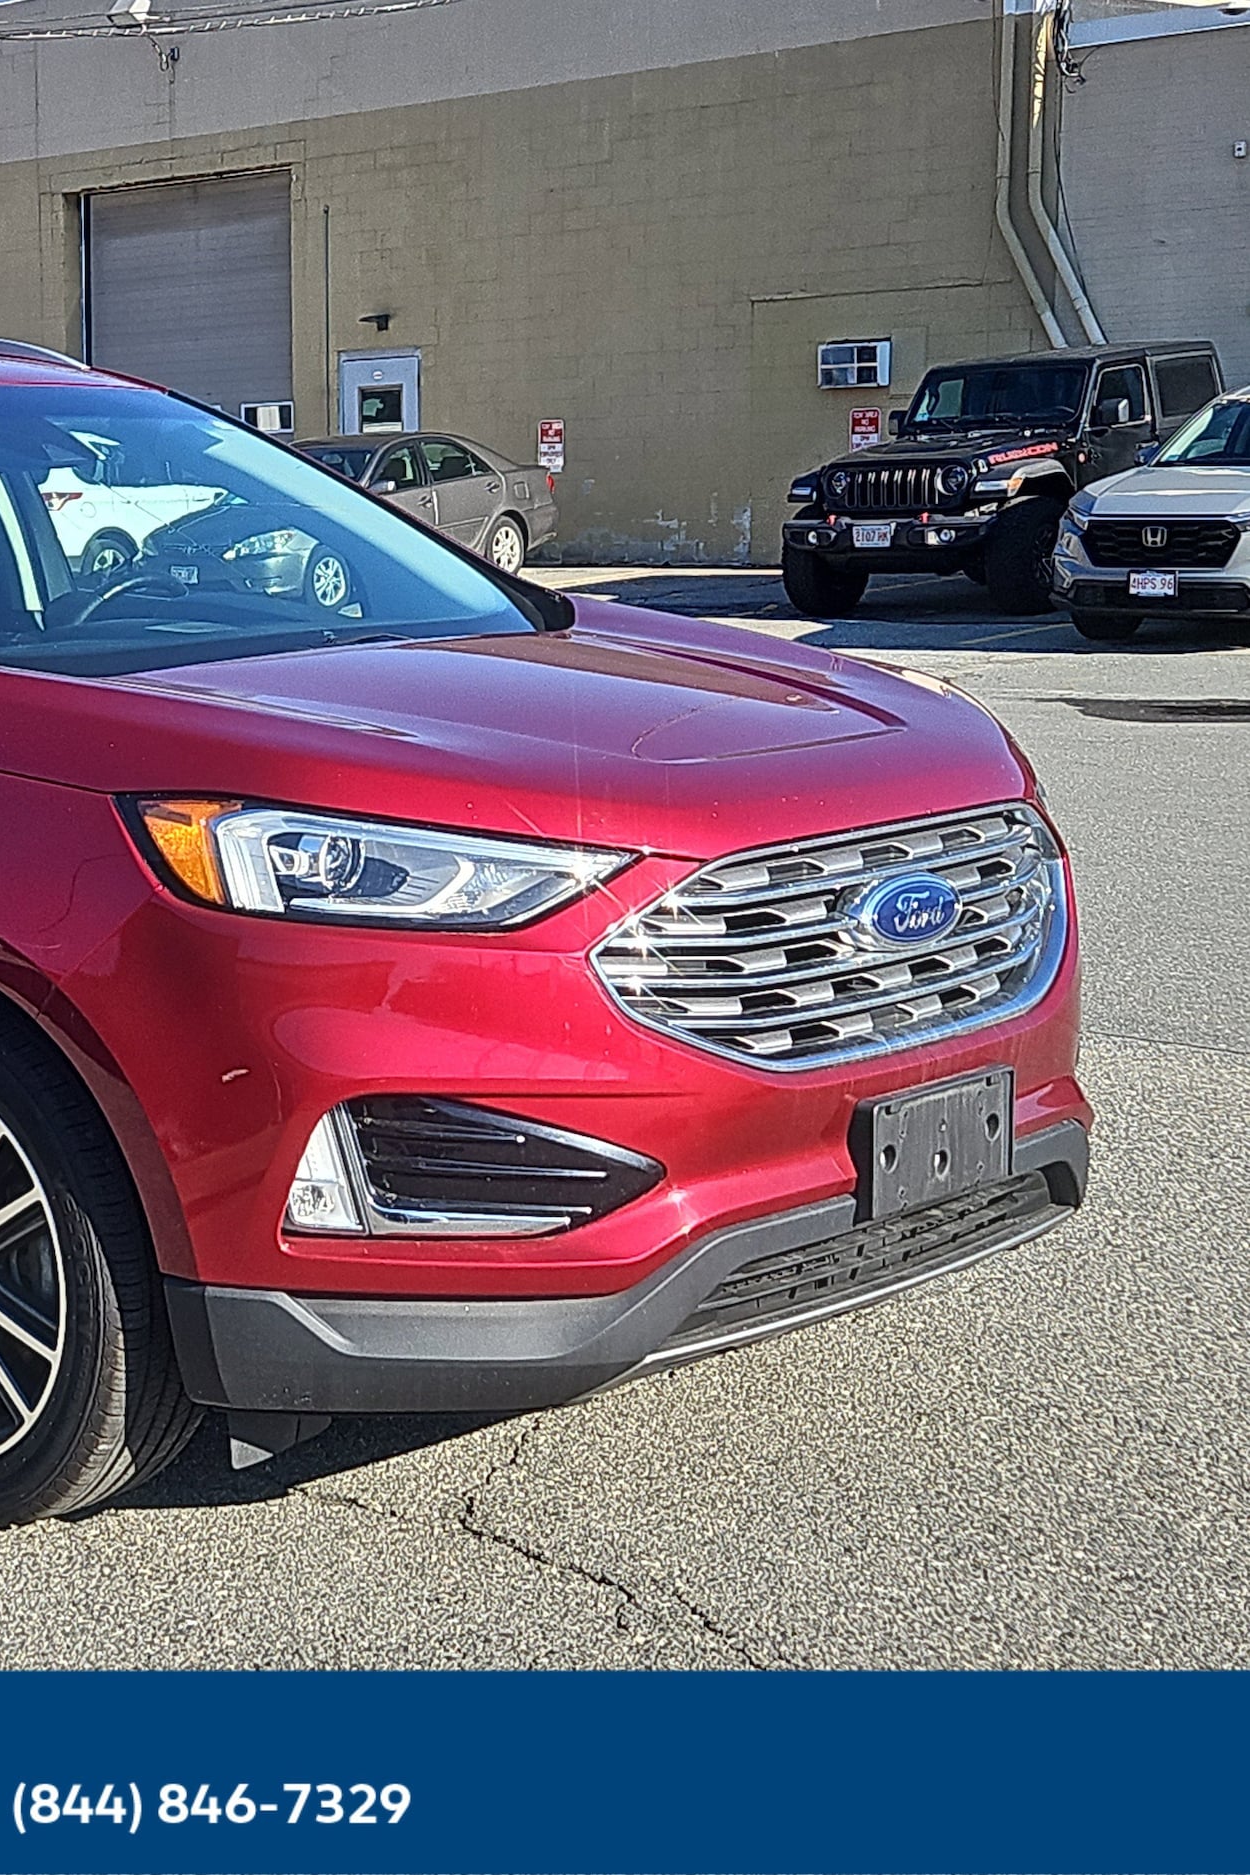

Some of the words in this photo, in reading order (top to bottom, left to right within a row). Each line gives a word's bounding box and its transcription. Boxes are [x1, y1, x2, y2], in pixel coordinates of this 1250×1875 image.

[987, 441, 1059, 465] RUBICON
[1131, 577, 1157, 590] 4HPS
[1160, 577, 1173, 590] 96
[893, 890, 945, 933] Ford
